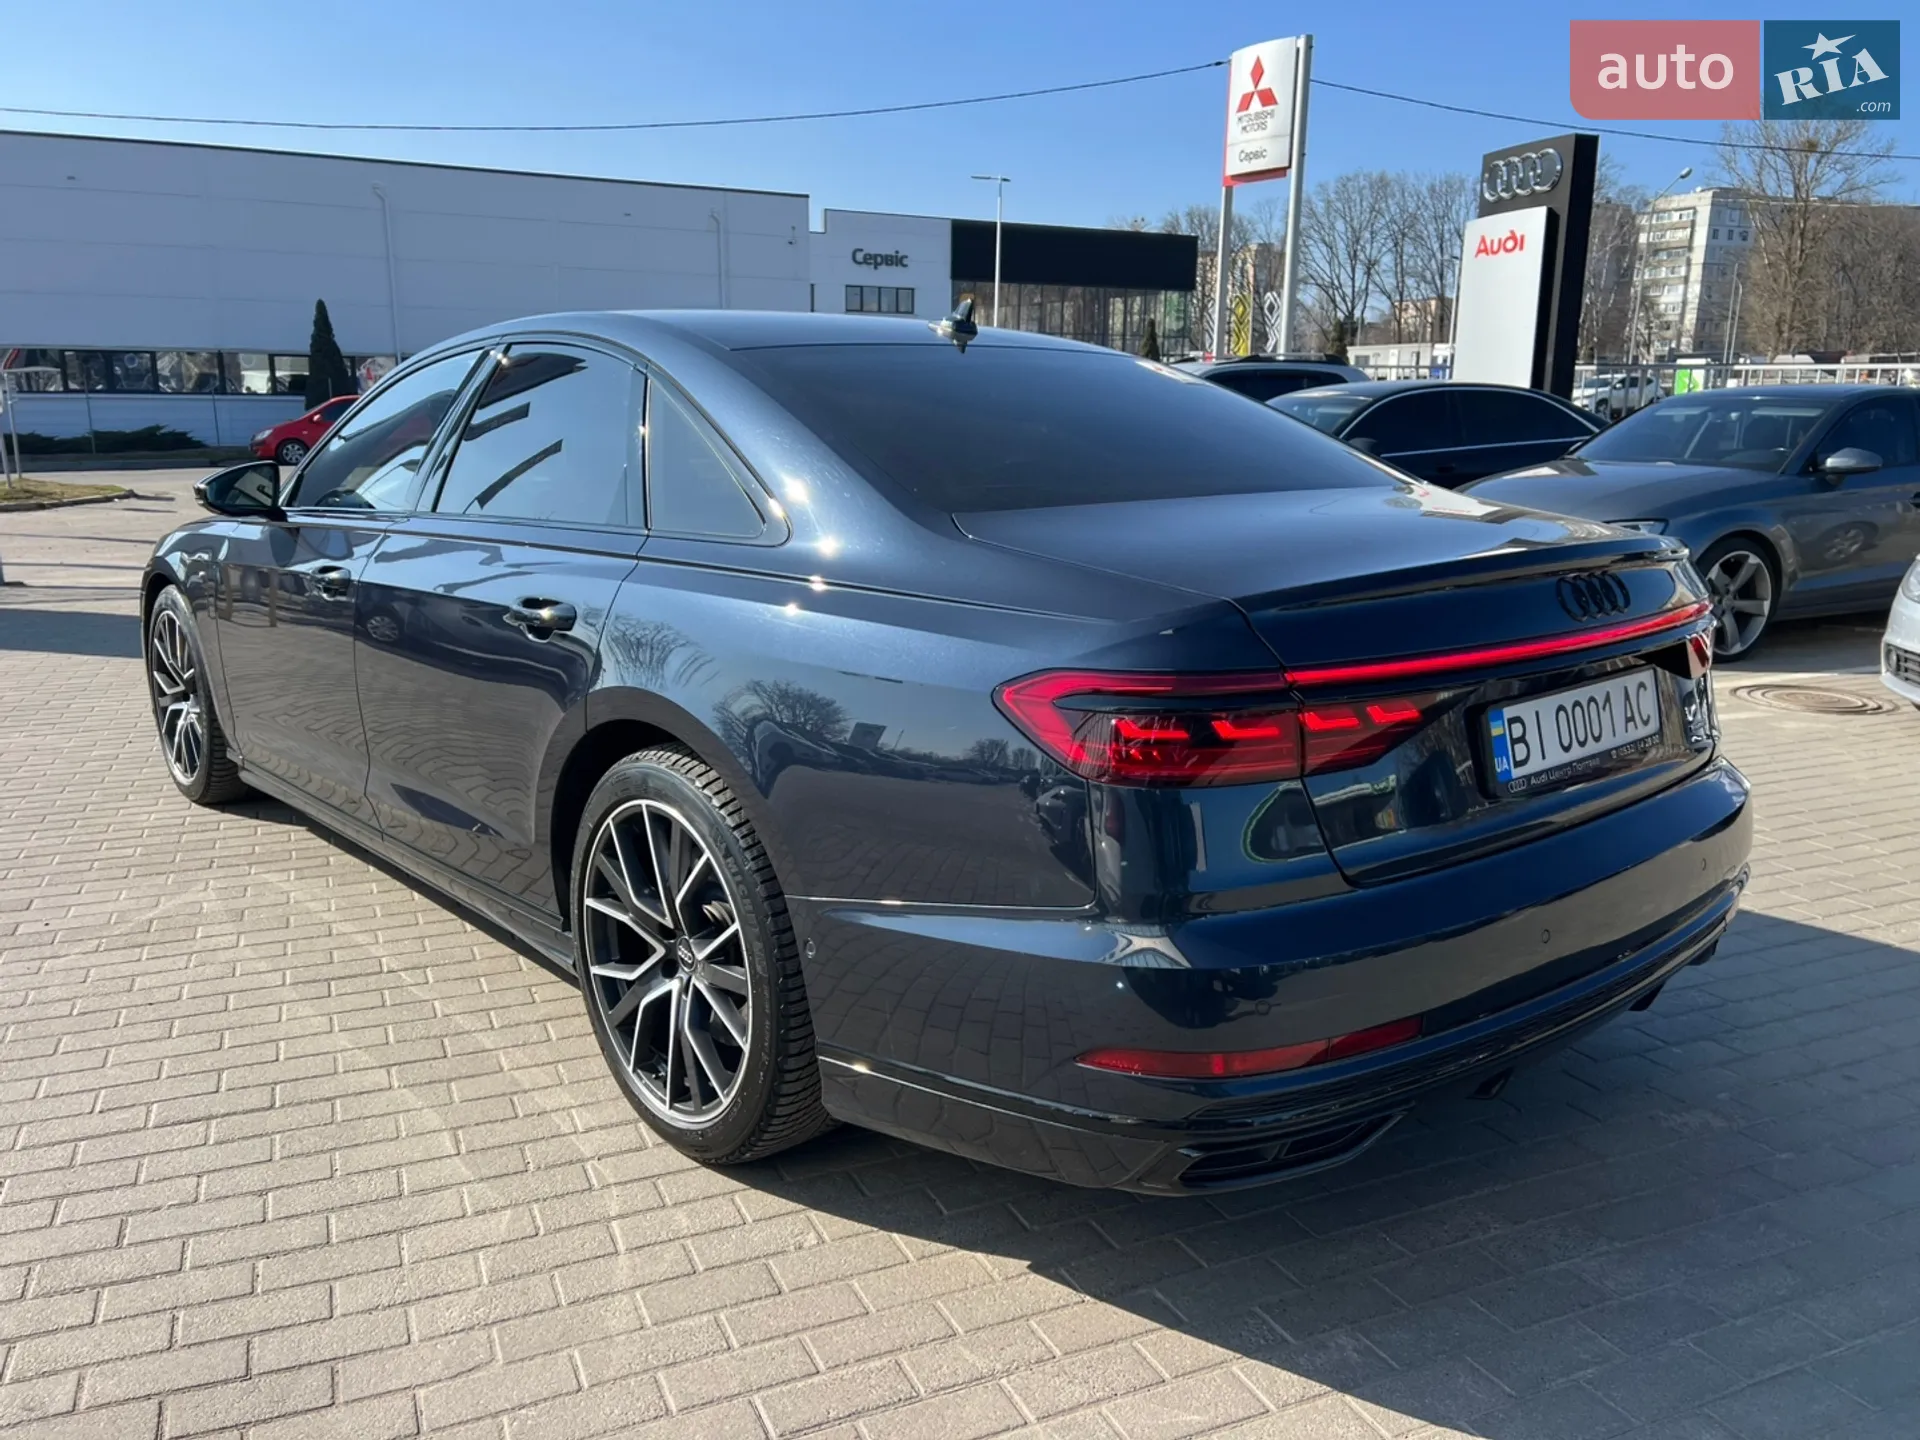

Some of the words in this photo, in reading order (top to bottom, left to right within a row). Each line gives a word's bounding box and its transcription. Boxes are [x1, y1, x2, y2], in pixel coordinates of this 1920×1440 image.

[1474, 229, 1525, 259] Audi
[851, 247, 909, 270] Сервіс
[1506, 710, 1546, 769] BI
[1555, 690, 1617, 753] 0001
[1624, 681, 1651, 734] AC
[1494, 756, 1510, 773] UA
[1530, 771, 1548, 786] Audi
